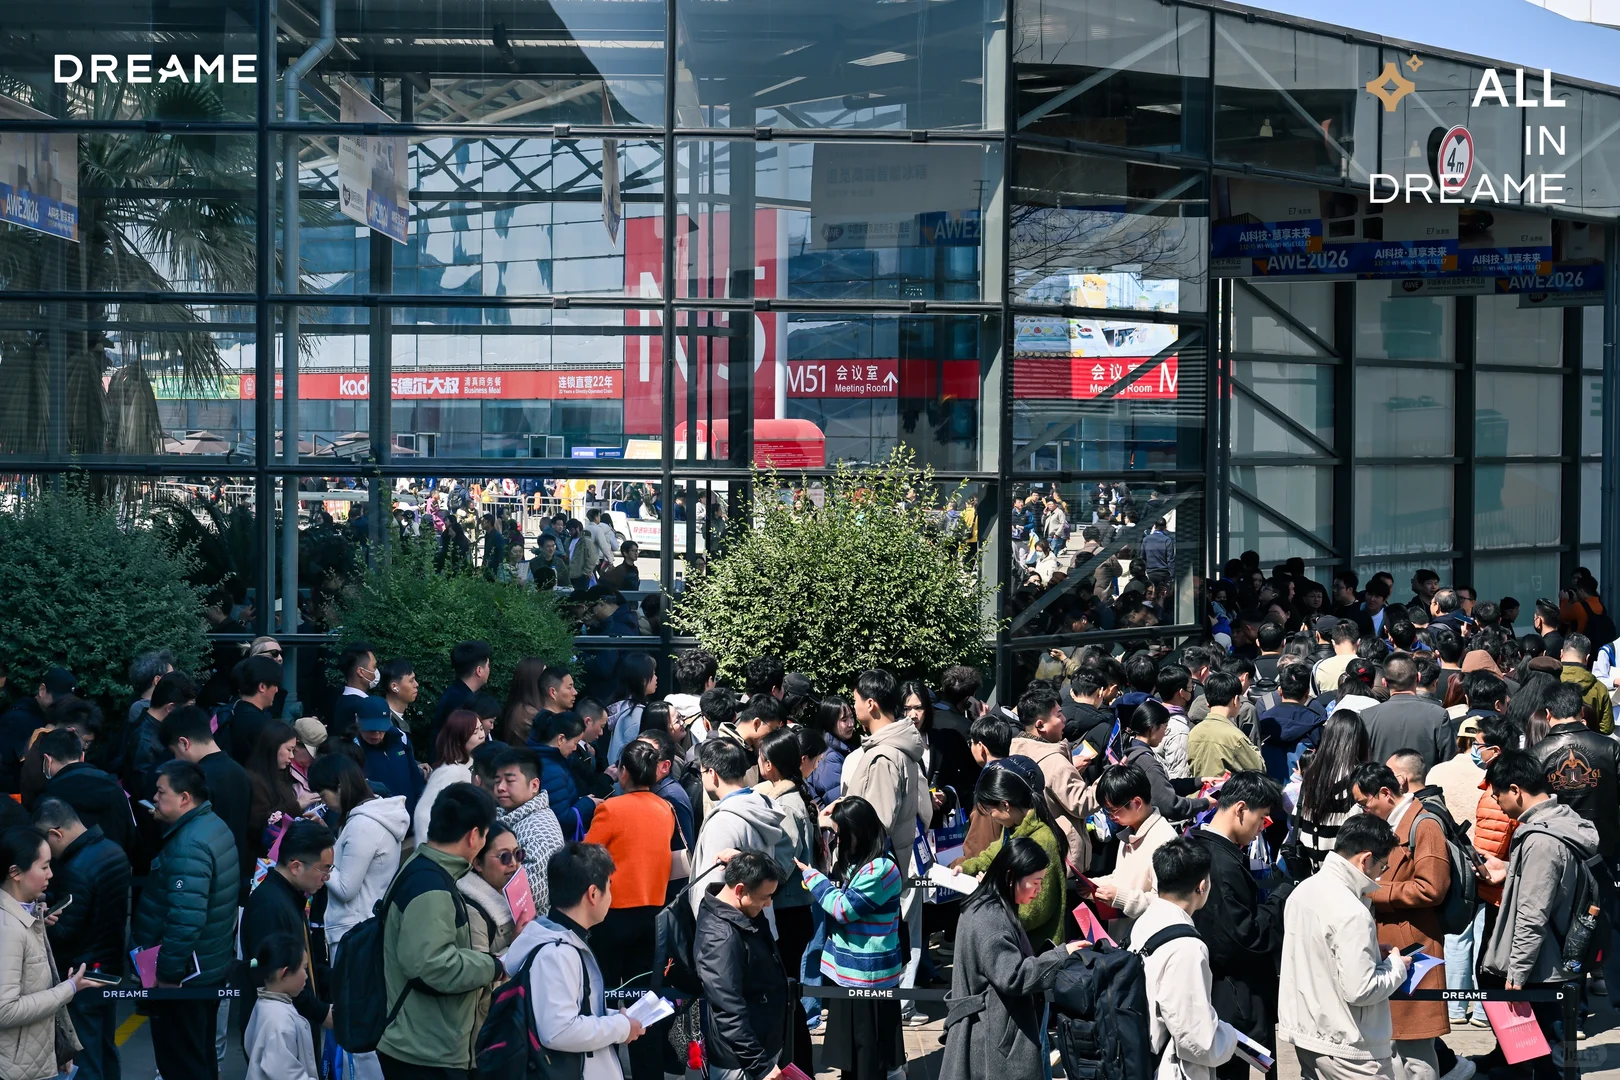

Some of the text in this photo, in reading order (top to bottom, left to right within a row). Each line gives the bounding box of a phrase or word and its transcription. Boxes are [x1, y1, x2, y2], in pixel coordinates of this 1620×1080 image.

[1447, 147, 1464, 173] 4m
[5, 193, 39, 223] AWE2026
[824, 228, 840, 238] AWE
[1267, 250, 1349, 270] AWE2026
[1404, 281, 1420, 289] AWE
[1508, 271, 1584, 289] AWE2026
[836, 365, 878, 380] 会议室
[559, 376, 612, 388] 连锁直营22年
[786, 365, 826, 392] M51
[340, 376, 370, 395] kad
[835, 384, 888, 394] Meeting Room
[1127, 383, 1152, 393] Room
[1591, 769, 1601, 778] 61
[103, 990, 148, 998] DREAME
[848, 989, 893, 998] DREAME
[1442, 991, 1487, 999] DREAME
